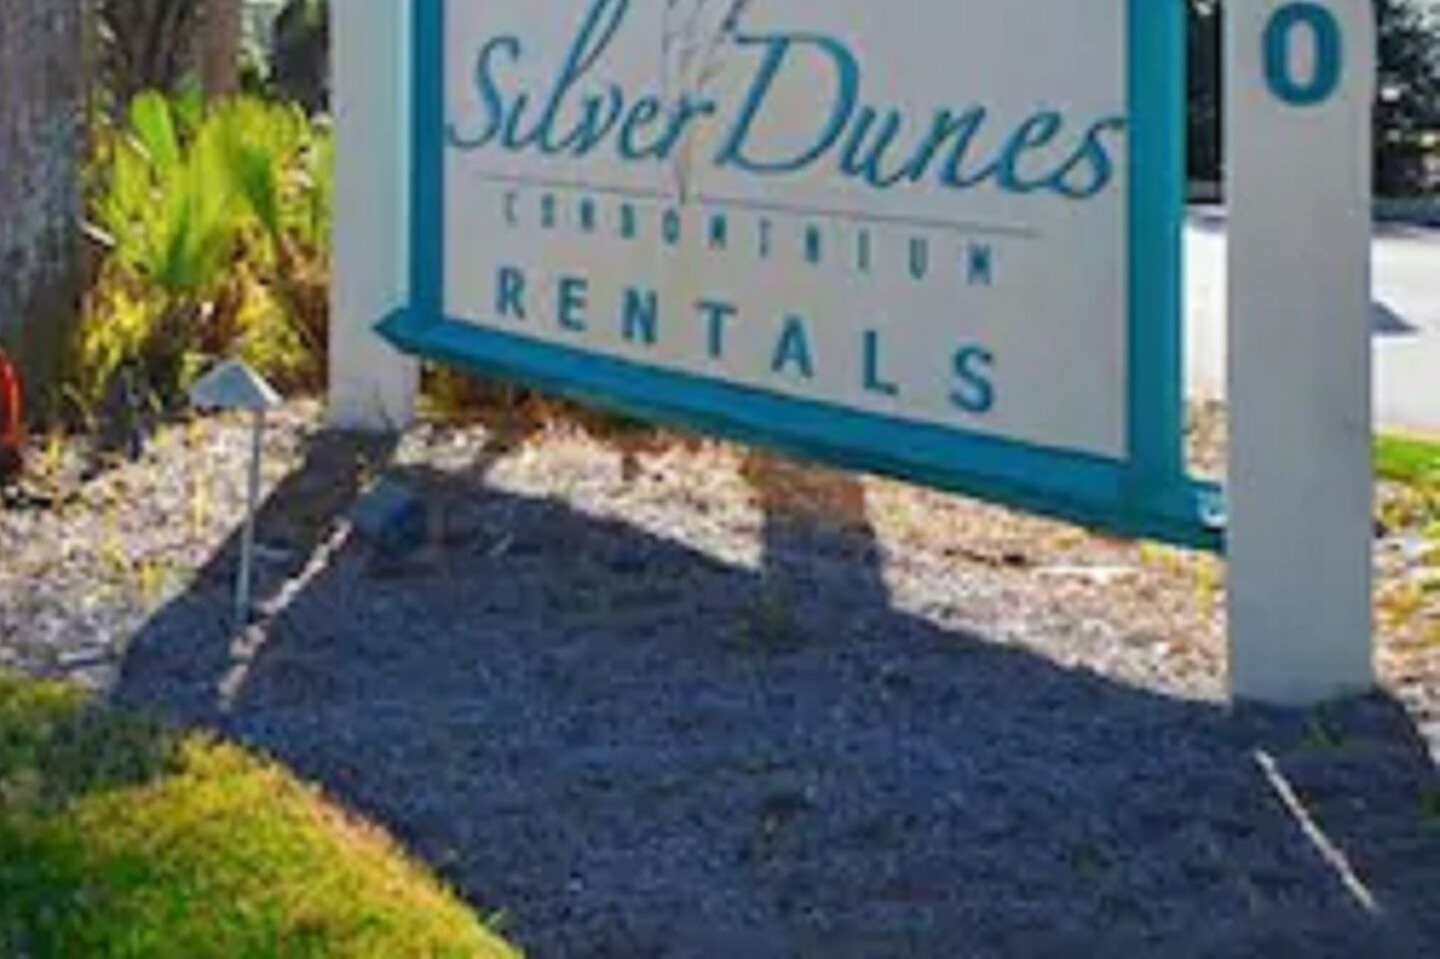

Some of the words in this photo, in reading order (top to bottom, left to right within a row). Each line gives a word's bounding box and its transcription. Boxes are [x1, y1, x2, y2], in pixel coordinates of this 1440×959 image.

[714, 31, 1126, 199] Dunes
[503, 191, 992, 286] CONDOMINIUM
[496, 265, 995, 413] RENTALS
